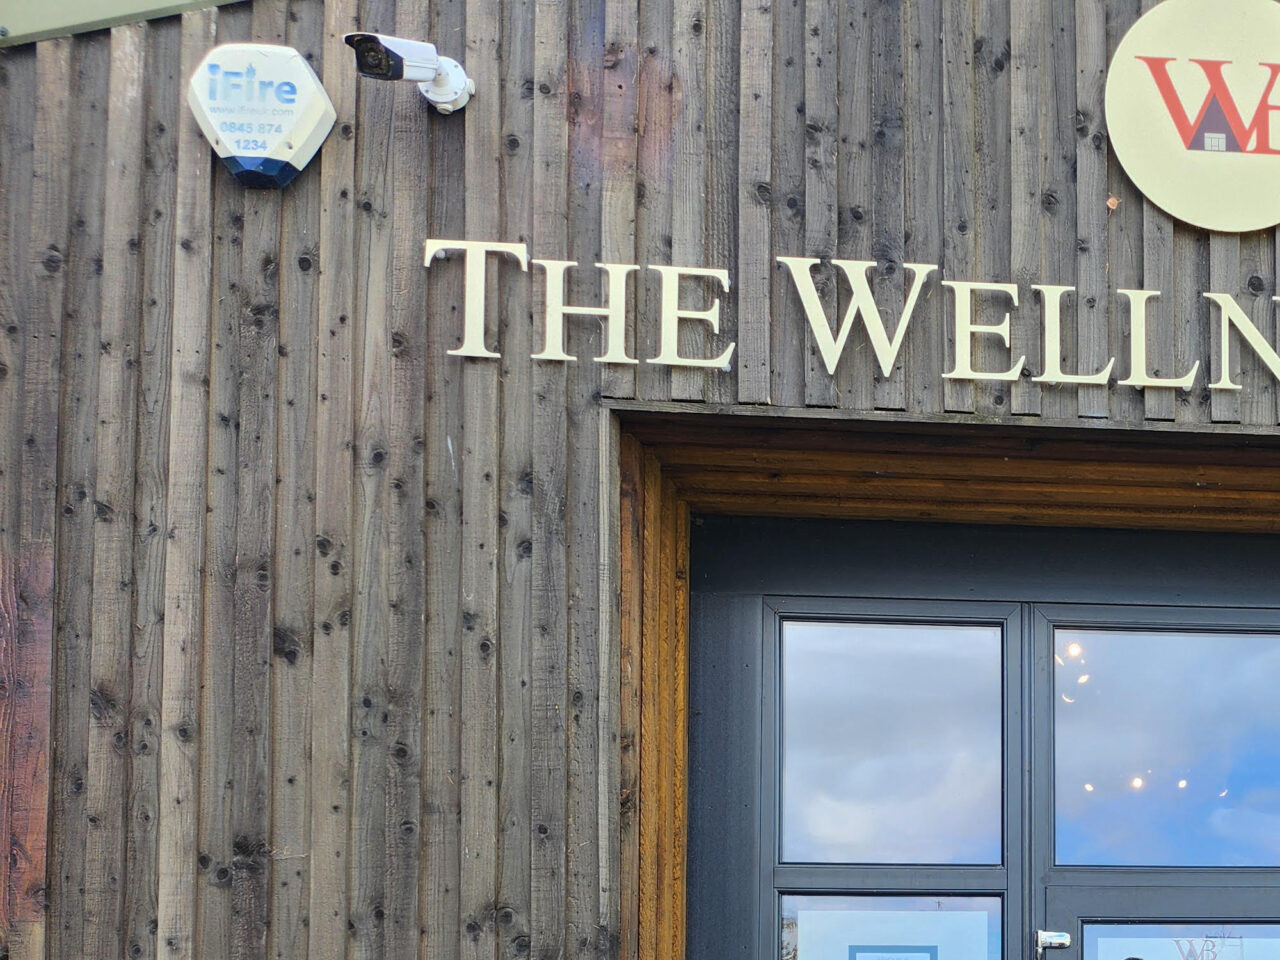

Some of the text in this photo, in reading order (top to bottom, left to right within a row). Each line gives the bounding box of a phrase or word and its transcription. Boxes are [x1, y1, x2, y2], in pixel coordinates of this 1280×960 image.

[207, 63, 297, 104] iFire
[220, 121, 283, 134] 0845 874
[234, 138, 268, 151] 1234
[424, 238, 736, 368] THE
